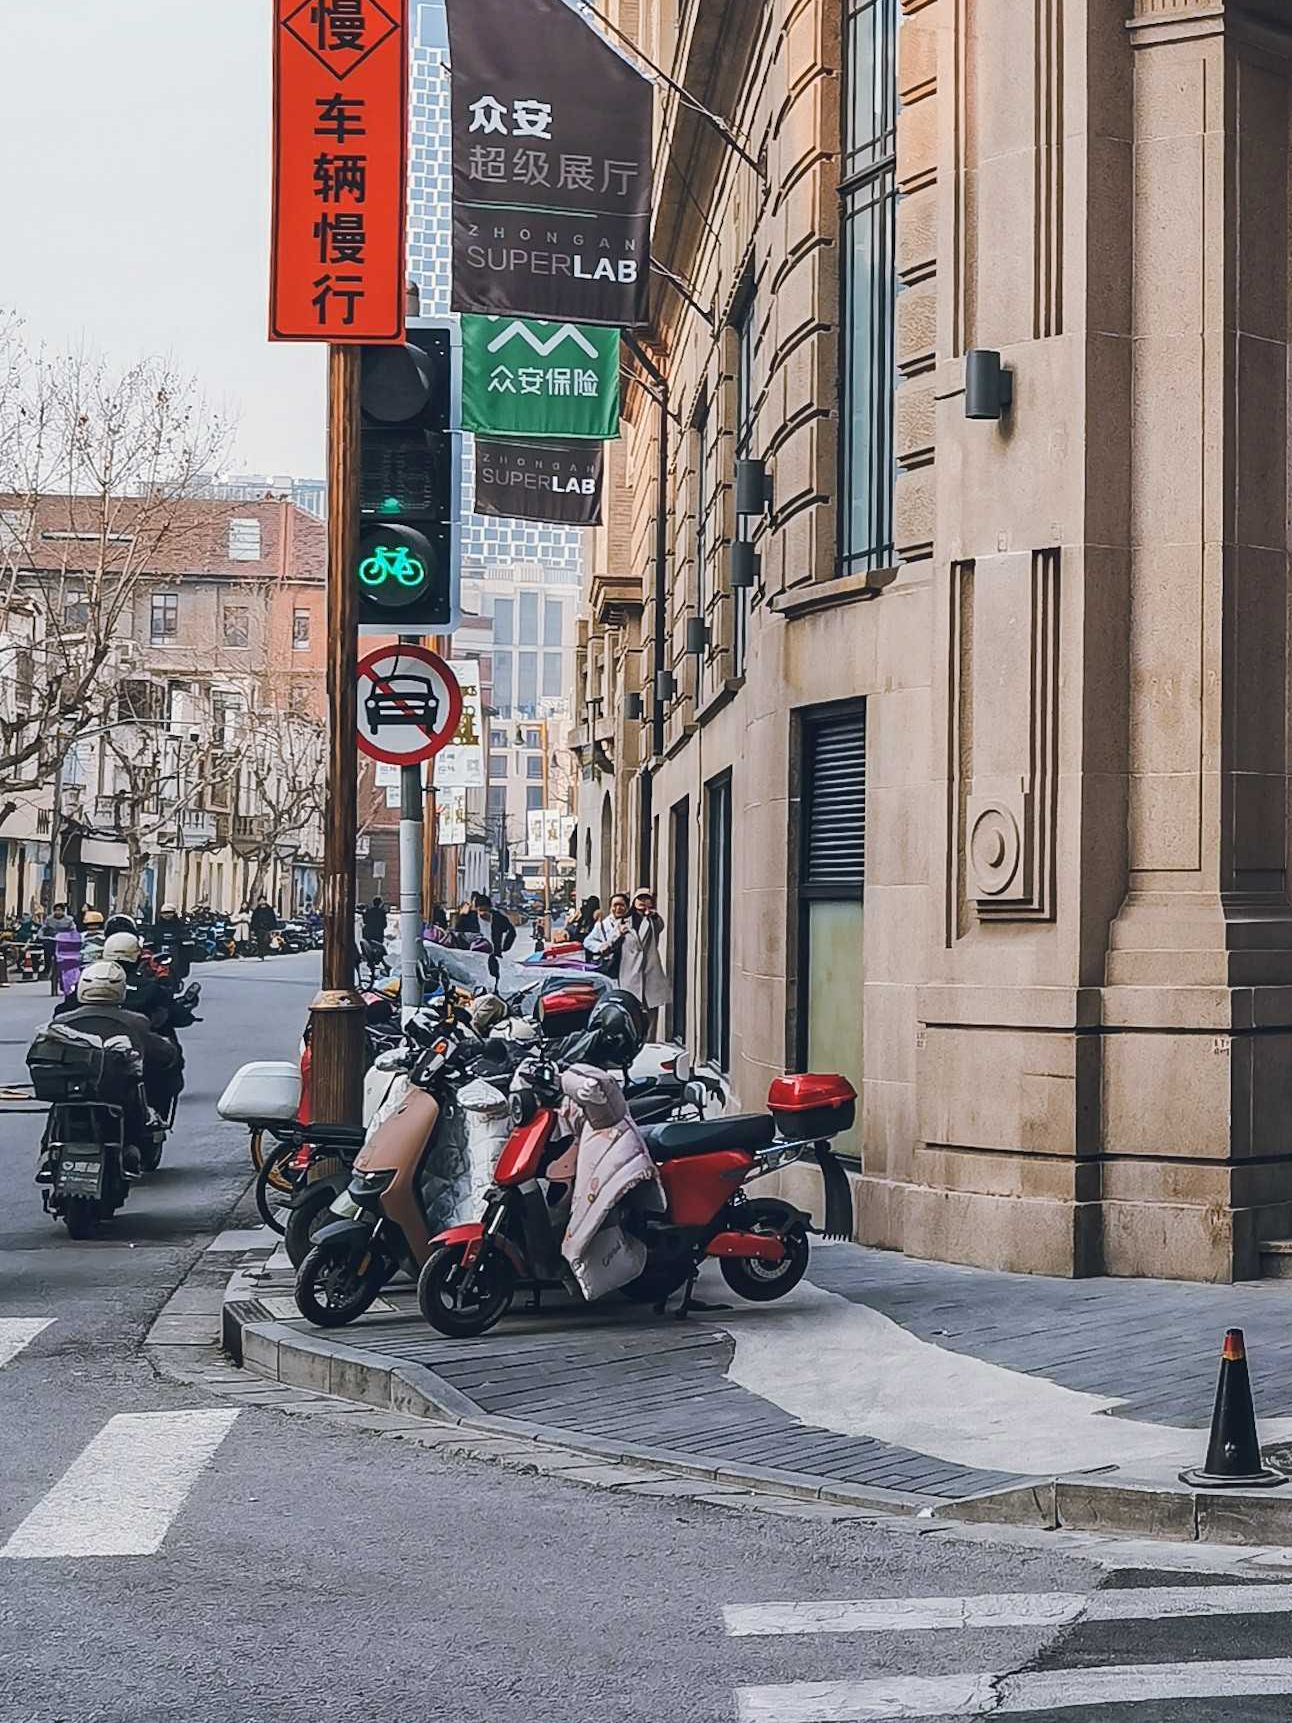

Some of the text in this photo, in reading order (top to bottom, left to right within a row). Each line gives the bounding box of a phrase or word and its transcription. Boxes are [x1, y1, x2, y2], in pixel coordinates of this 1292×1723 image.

[468, 95, 553, 140] 众安
[468, 144, 639, 196] 超级展厅
[311, 92, 368, 326] 车辆慢行
[467, 223, 636, 252] ZHONGAN
[466, 245, 638, 284] SUPERLAB
[487, 364, 599, 398] 众安保险
[482, 467, 597, 495] SUPERLAB
